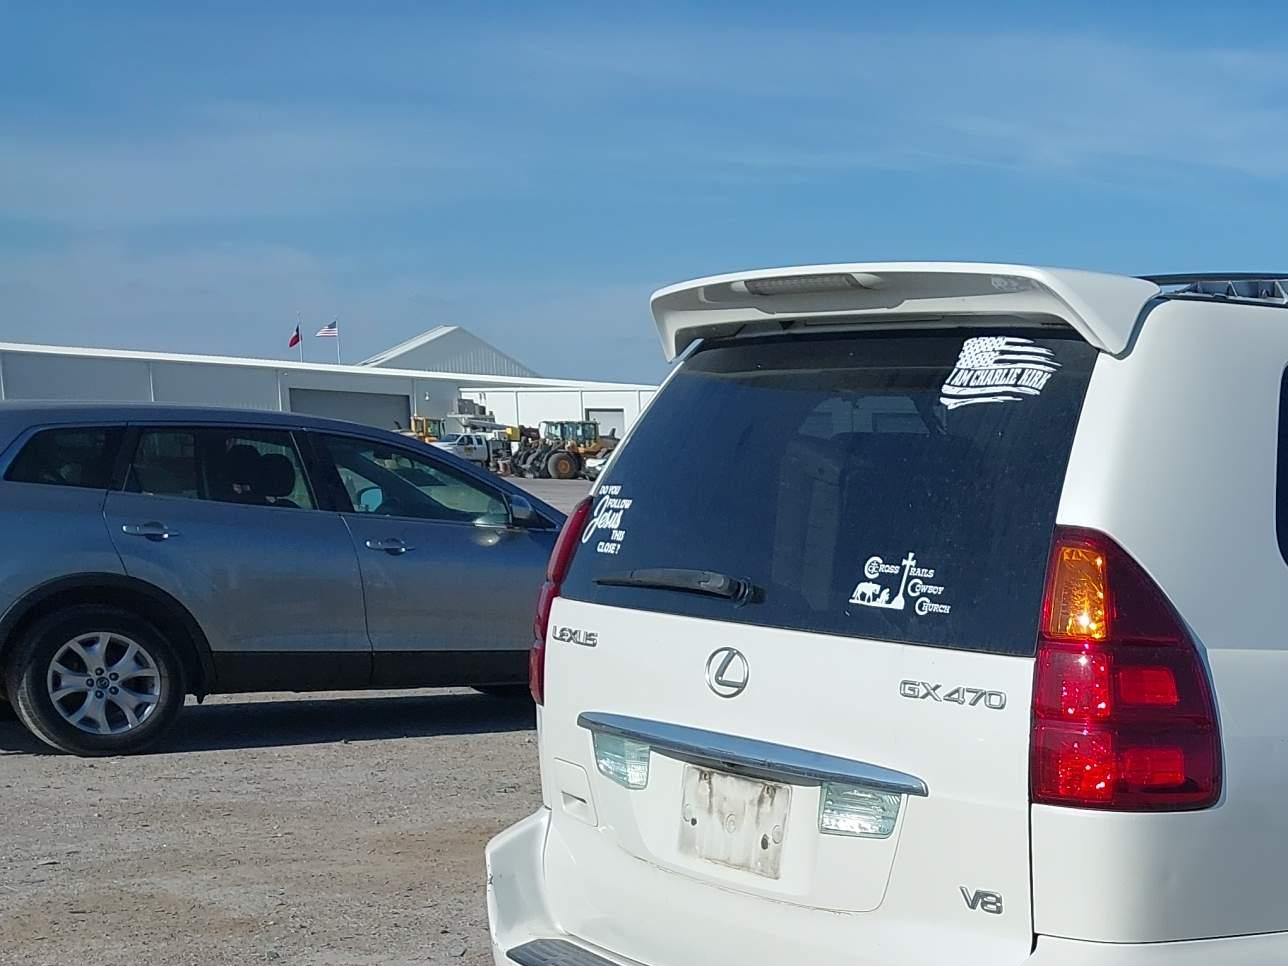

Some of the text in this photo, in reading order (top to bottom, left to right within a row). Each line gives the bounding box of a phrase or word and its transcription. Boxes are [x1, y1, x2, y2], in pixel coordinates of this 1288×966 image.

[950, 369, 974, 386] AM
[969, 368, 1022, 387] CHARLIE
[1017, 368, 1051, 390] KIRK
[599, 485, 622, 495] DO YOU
[606, 499, 633, 509] FOLLOW
[582, 495, 624, 544] Jesus
[611, 530, 626, 541] THIS
[864, 556, 900, 579] CROSS
[907, 579, 944, 597] COWBOY
[915, 597, 951, 616] CHURCH
[552, 625, 598, 647] LEXUS
[959, 885, 1004, 915] V8
